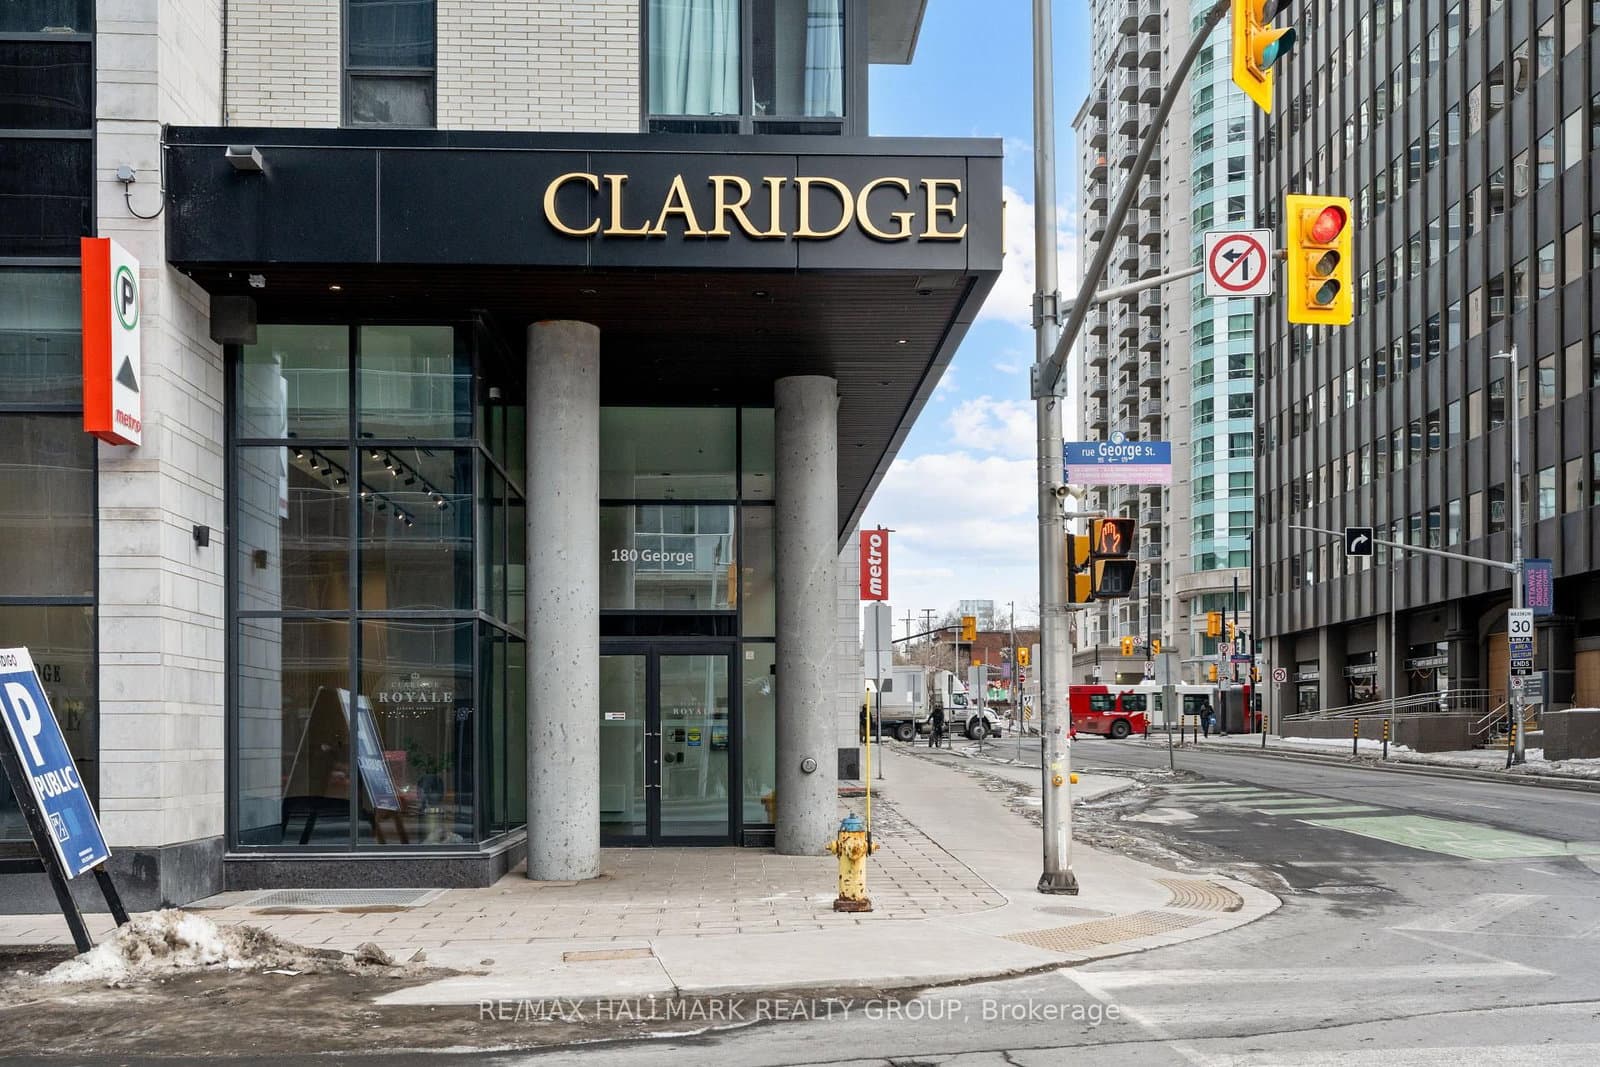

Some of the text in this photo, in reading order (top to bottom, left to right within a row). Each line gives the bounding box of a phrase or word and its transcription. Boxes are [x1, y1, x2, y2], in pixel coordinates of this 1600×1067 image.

[543, 172, 967, 240] CLARIDGE
[121, 276, 134, 315] P
[115, 408, 142, 434] metro
[1081, 449, 1095, 457] rue
[1098, 442, 1142, 460] George
[611, 548, 694, 566] 180 George
[867, 533, 882, 596] metro
[1511, 620, 1531, 633] 30
[379, 691, 453, 703] ROYALE
[5, 682, 44, 767] P
[34, 766, 79, 800] PUBLIC
